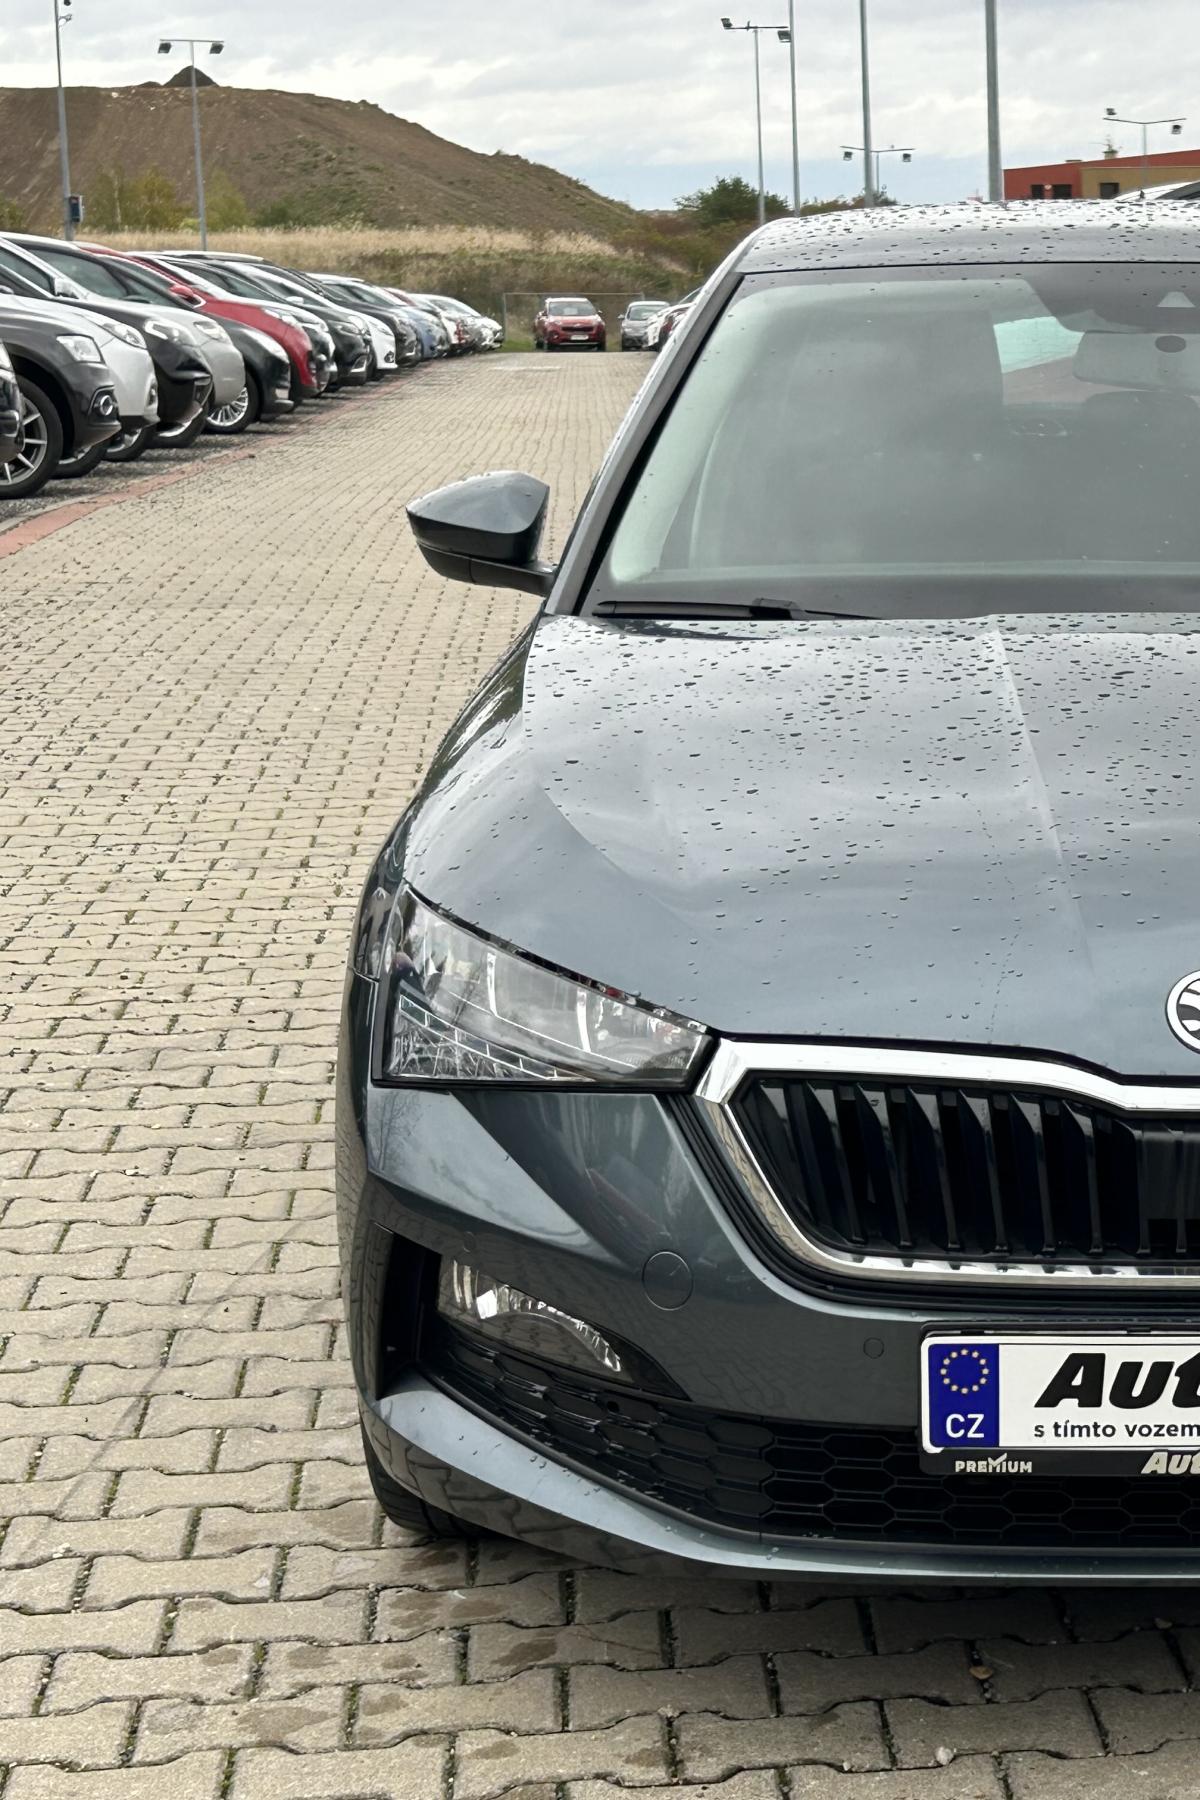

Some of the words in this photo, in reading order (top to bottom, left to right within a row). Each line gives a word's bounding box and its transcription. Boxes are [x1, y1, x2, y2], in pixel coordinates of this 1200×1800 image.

[945, 1413, 985, 1439] CZ
[1034, 1424, 1045, 1438] s
[1053, 1421, 1117, 1438] tímto
[1124, 1424, 1200, 1438] vozem
[955, 1453, 1033, 1473] PREMIUM
